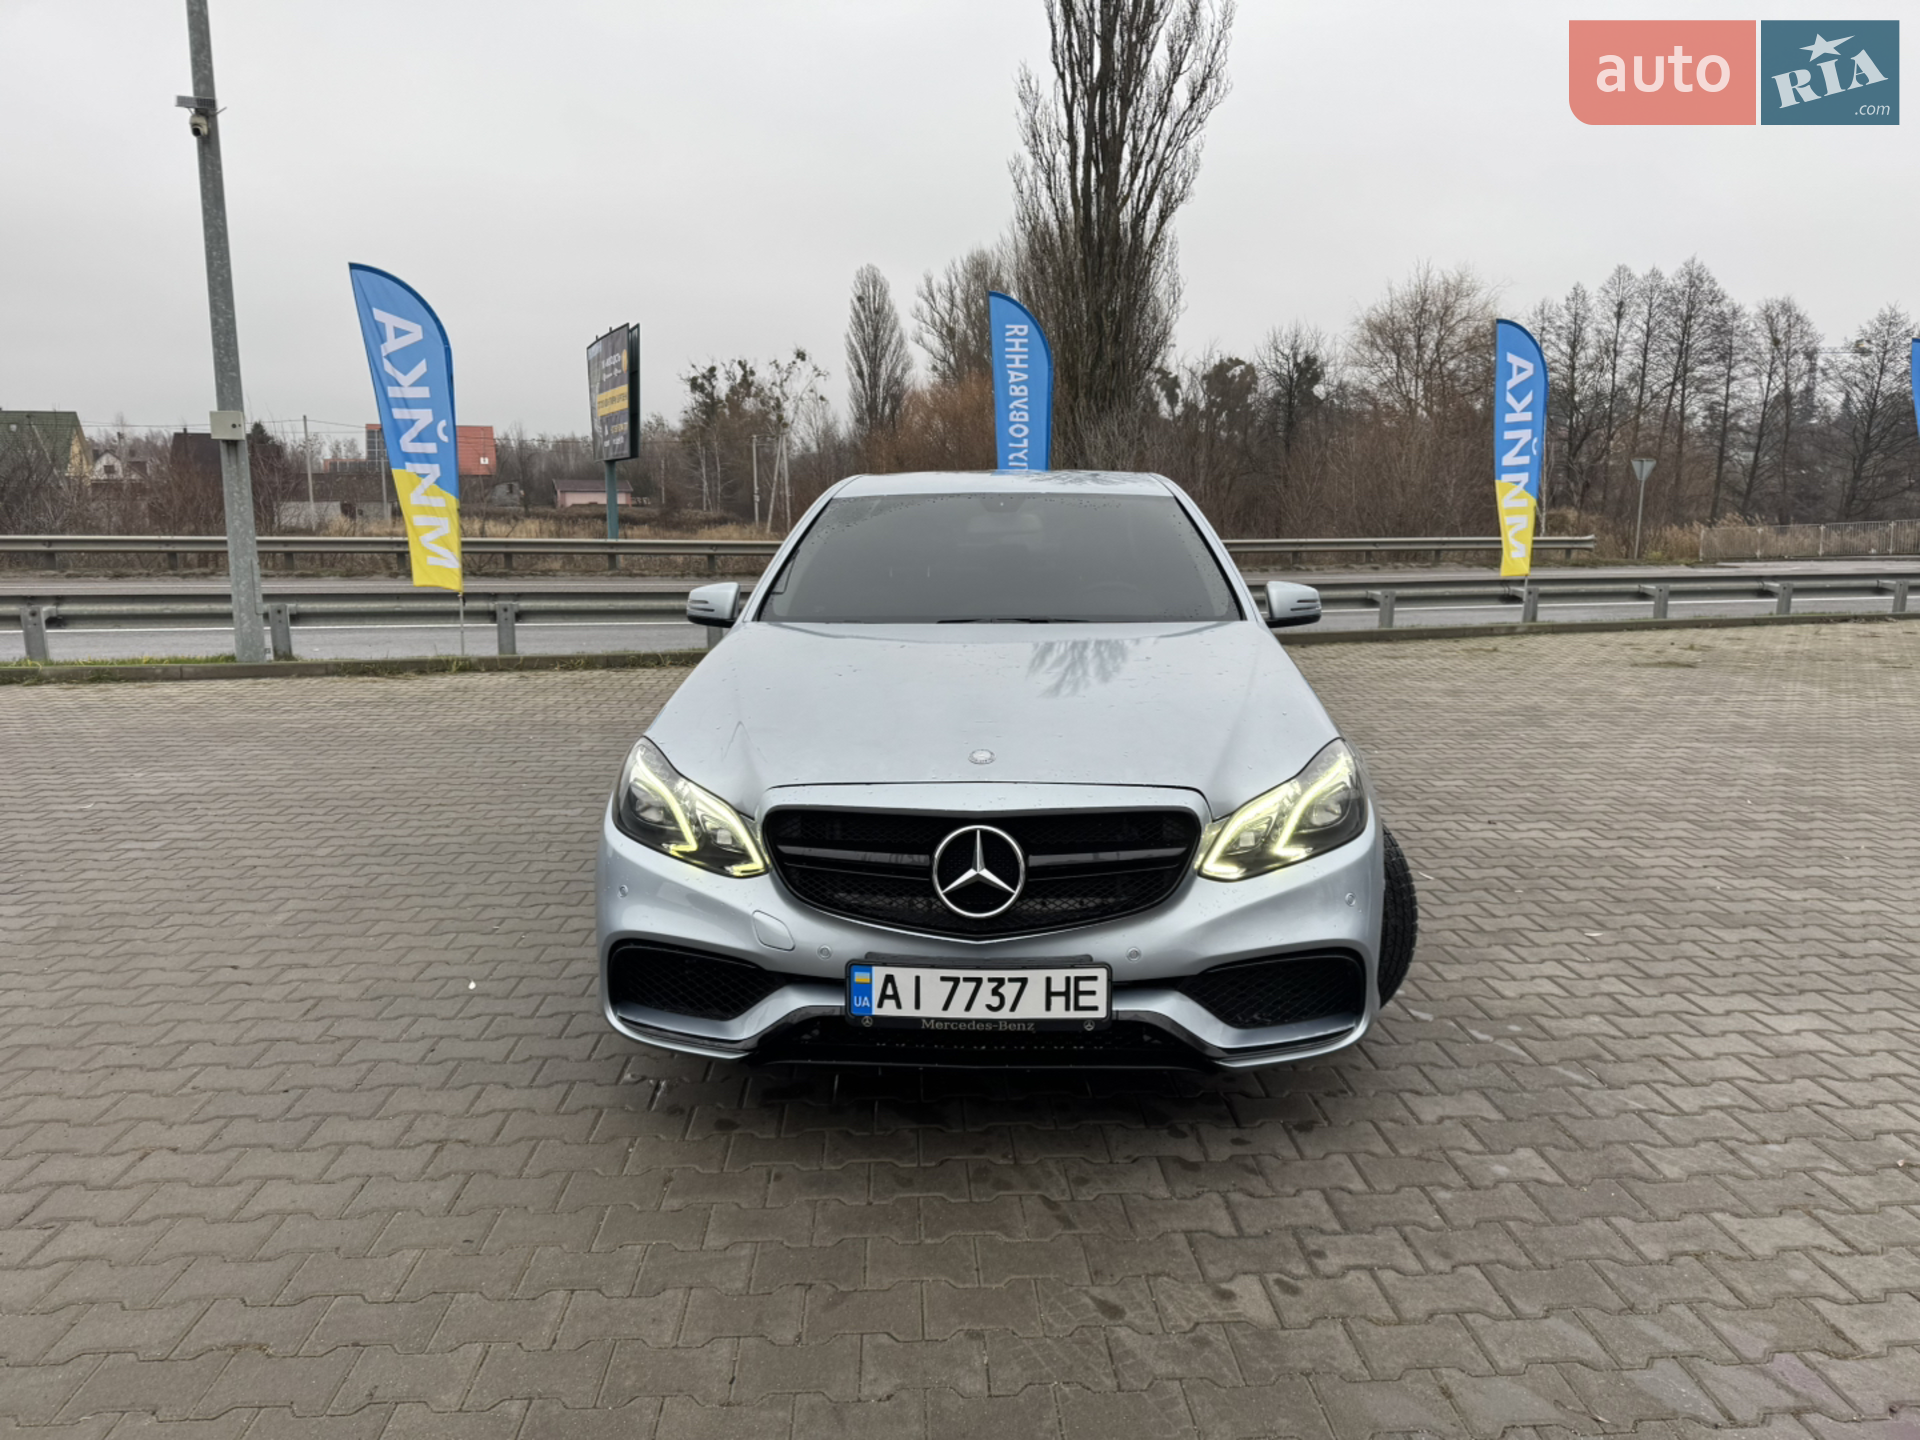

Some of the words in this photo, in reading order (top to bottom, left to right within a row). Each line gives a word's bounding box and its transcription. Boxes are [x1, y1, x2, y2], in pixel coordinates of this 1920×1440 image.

[877, 974, 921, 1010] AI
[940, 976, 1029, 1012] 7737
[1045, 976, 1099, 1011] HE
[854, 996, 871, 1008] UA
[921, 1018, 1035, 1032] Mercedes-Benz
